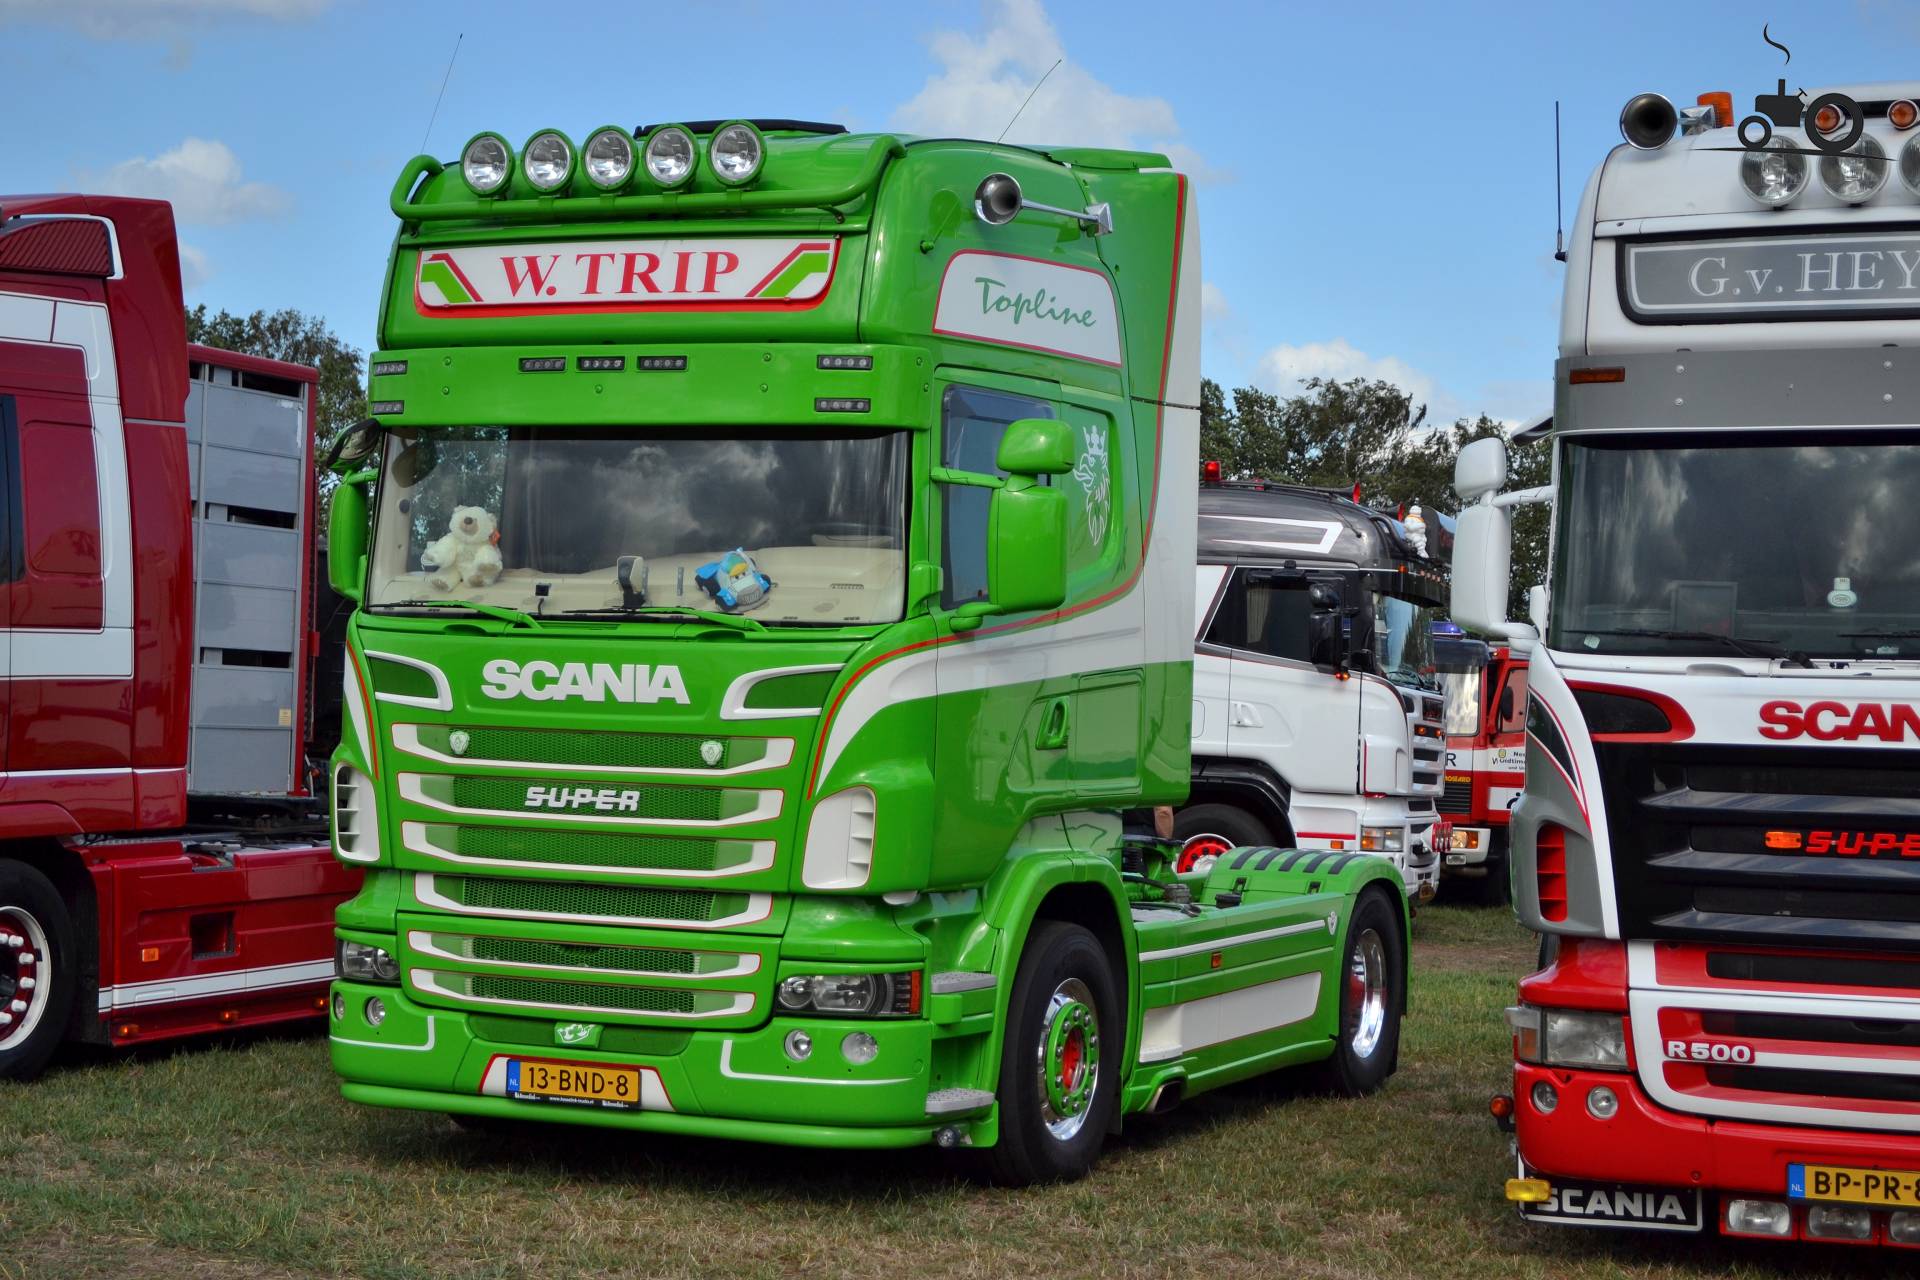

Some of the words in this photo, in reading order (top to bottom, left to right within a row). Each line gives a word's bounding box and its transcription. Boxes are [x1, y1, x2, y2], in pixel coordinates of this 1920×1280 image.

[500, 254, 561, 297] W.
[575, 251, 739, 295] TRIP
[1795, 249, 1920, 292] HEY
[974, 276, 1097, 327] Topline
[481, 659, 691, 705] SCANIA
[1758, 700, 1920, 742] SCAN
[525, 786, 640, 811] SUPER
[509, 1078, 519, 1087] NL
[529, 1066, 629, 1096] 13-BND-8
[1791, 1183, 1804, 1192] NL
